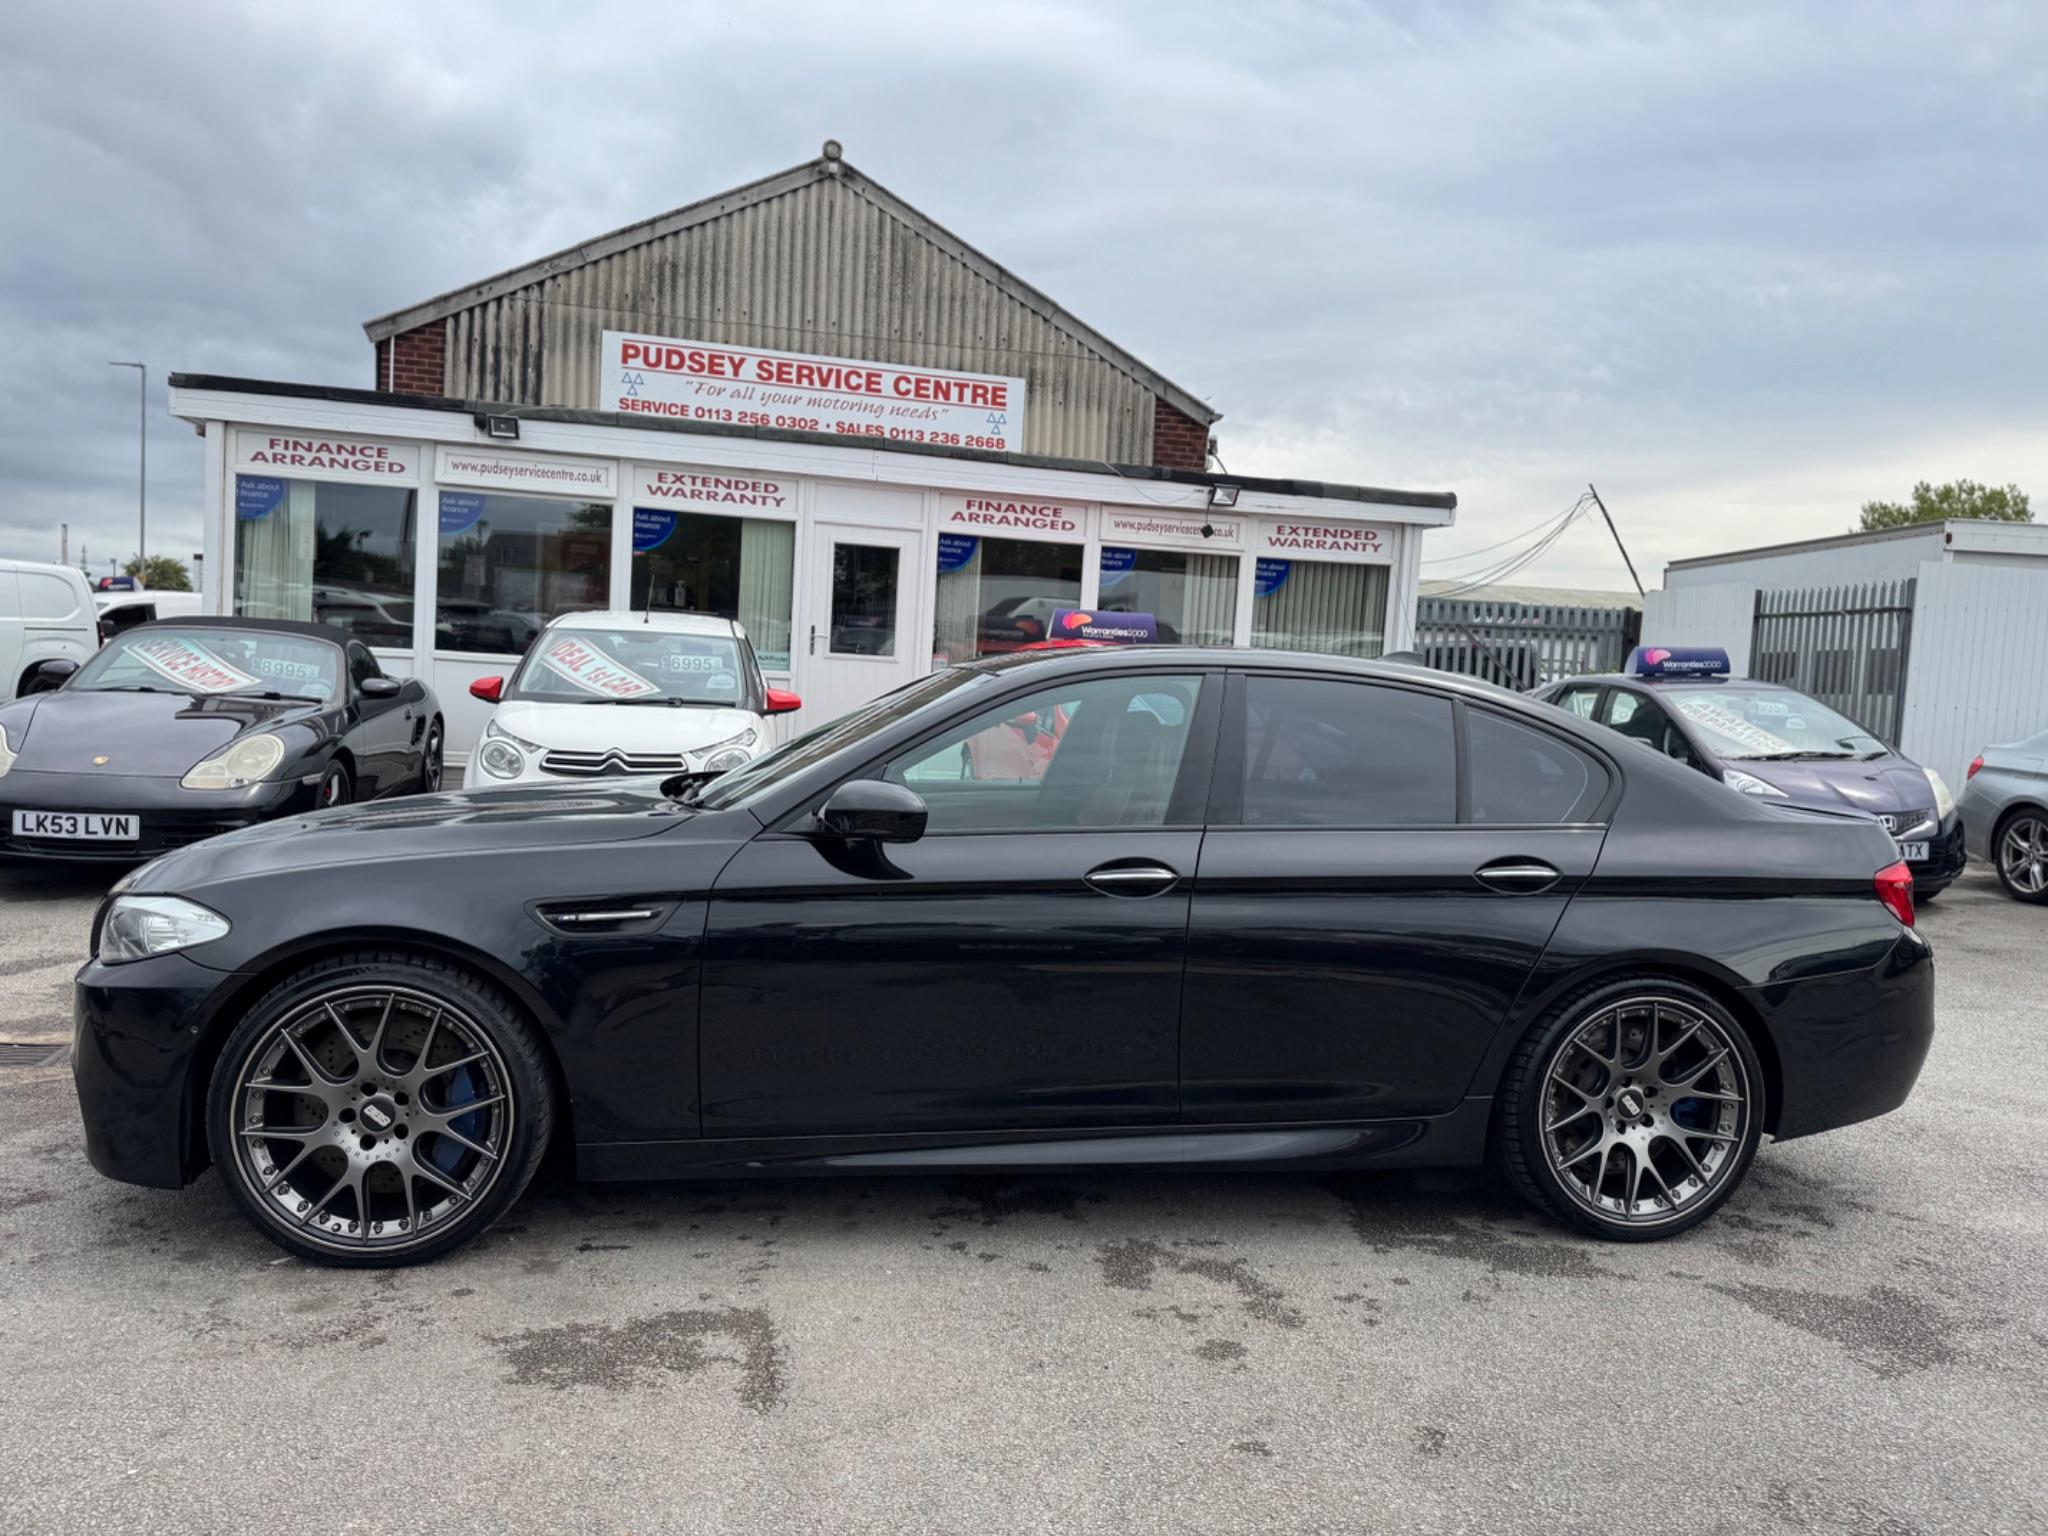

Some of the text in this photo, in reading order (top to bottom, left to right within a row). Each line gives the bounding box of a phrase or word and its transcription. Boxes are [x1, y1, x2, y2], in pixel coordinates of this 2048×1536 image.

[620, 342, 1008, 408] PUDSEY SERVICE CENTRE
[729, 385, 755, 400] all
[760, 391, 801, 407] your
[806, 396, 885, 418] motoring
[618, 397, 1005, 449] SERVICE 0113 256 0302 SALES 0113 236 2668
[268, 438, 389, 459] FINANCE
[250, 451, 406, 474] ARRANGED
[451, 459, 602, 483] www.pudseyservicecentre.co.uk
[240, 481, 280, 491] Ask about
[657, 472, 780, 494] EXTENDED
[240, 489, 269, 498] finance
[441, 496, 480, 507] Ask about
[646, 484, 786, 507] WARRANTY
[441, 505, 469, 514] finance
[635, 512, 671, 523] Ask about
[966, 499, 1063, 519] FINANCE
[634, 520, 661, 530] finance
[950, 511, 1076, 531] ARRANGED
[1113, 518, 1234, 538] www.pudseyservicecen.co.uk
[940, 537, 972, 548] Ask about
[1276, 525, 1378, 540] EXTENDED
[1267, 536, 1383, 553] WARRANTY
[1082, 626, 1148, 638] Warranties2000
[1663, 660, 1722, 669] Warranties2000
[600, 676, 643, 696] CAR
[22, 813, 129, 836] LK53 LVN
